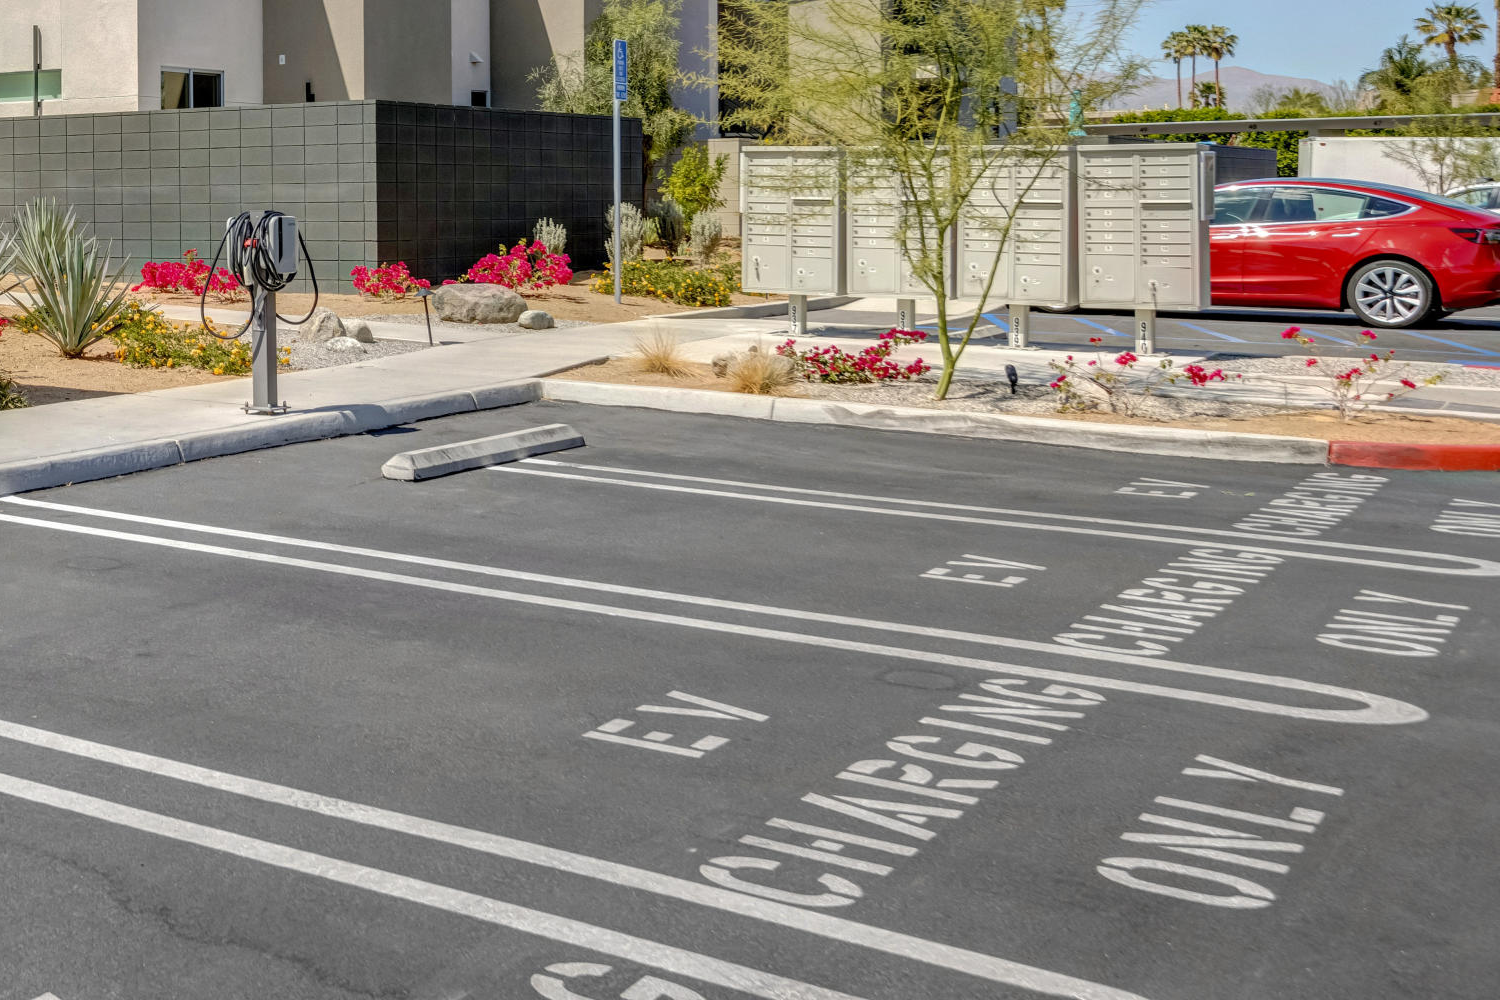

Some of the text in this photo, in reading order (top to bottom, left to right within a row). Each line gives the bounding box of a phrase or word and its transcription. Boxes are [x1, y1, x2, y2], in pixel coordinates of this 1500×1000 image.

[1113, 476, 1211, 499] EV
[1231, 472, 1390, 536] CHARGING
[918, 553, 1047, 588] EV
[1051, 548, 1286, 656] CHARGING
[1315, 589, 1471, 657] ONLY
[581, 690, 771, 759] EV
[699, 678, 1107, 908] CHARGING
[1096, 753, 1345, 909] ONLY
